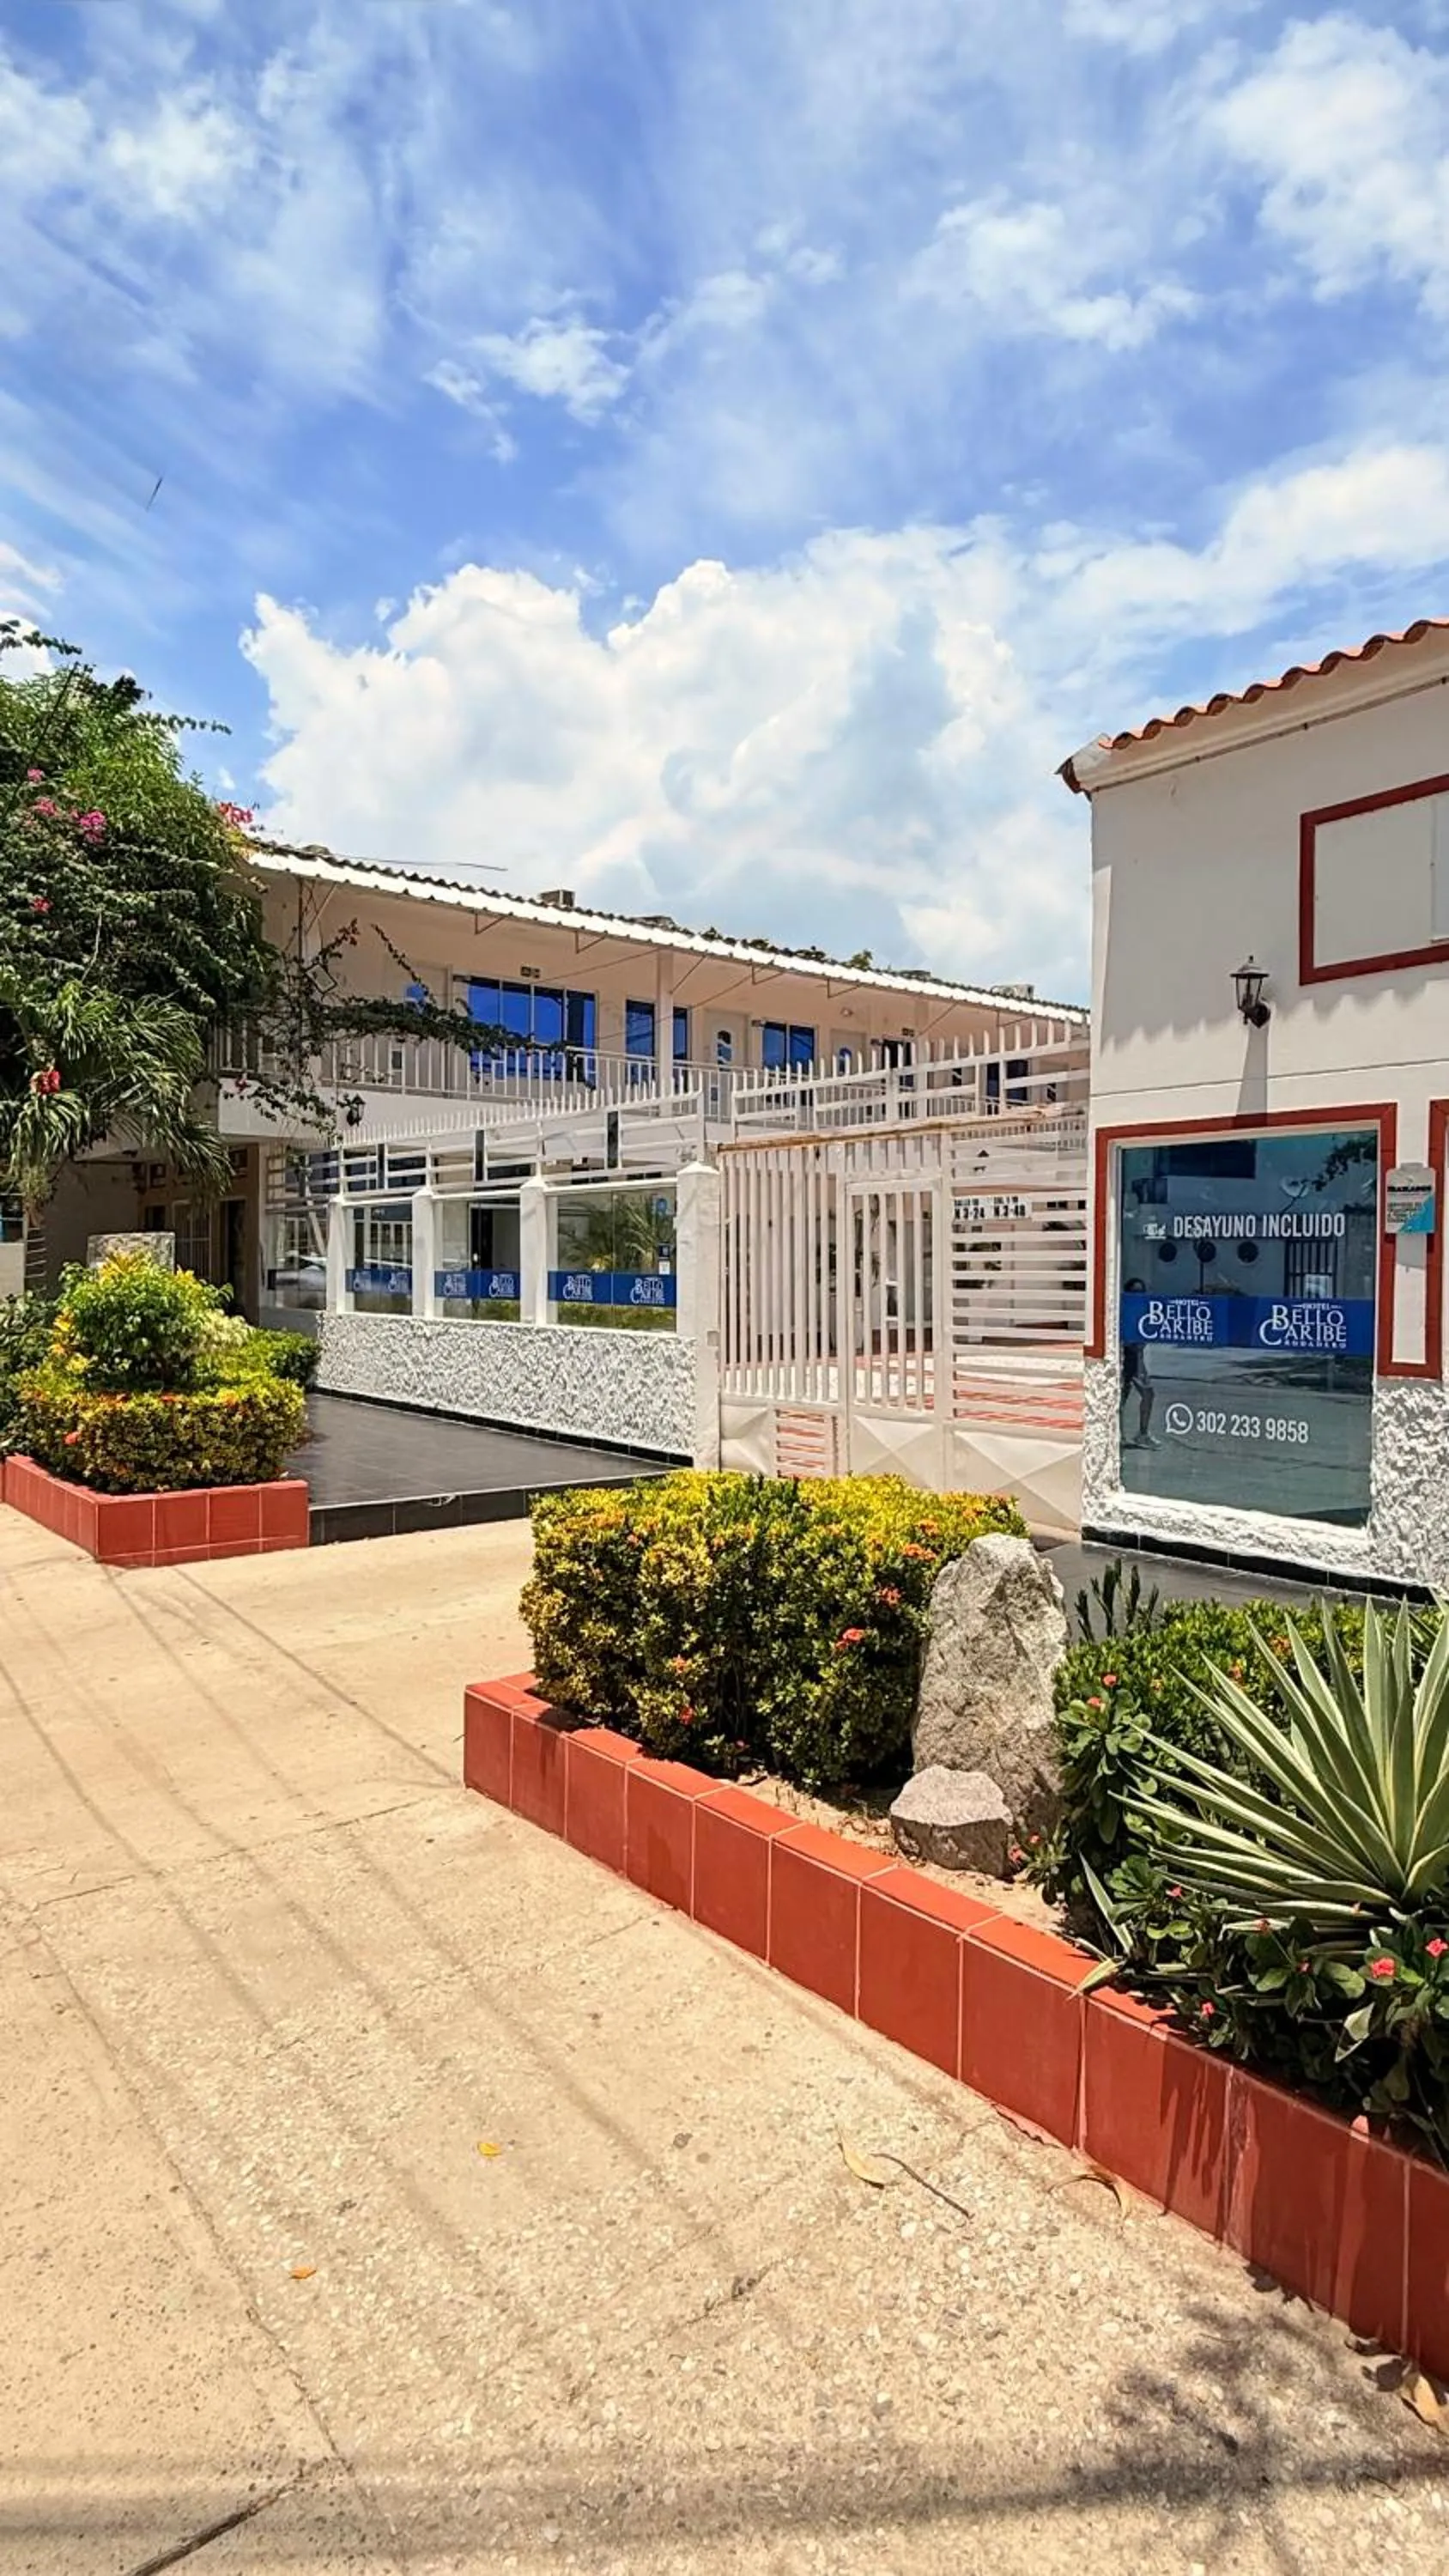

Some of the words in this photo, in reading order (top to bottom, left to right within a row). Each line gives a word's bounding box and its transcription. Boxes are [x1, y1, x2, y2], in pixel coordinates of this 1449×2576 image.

[1173, 1215, 1256, 1238] DESAYUNO
[1262, 1212, 1346, 1237] INCLUIDO
[1149, 1301, 1211, 1325] BELLO
[1271, 1304, 1344, 1330] BELLO
[1138, 1314, 1214, 1339] CARIBE
[1259, 1318, 1347, 1346] CARIBE
[1197, 1411, 1227, 1435] 302
[1230, 1414, 1261, 1438] 233
[1265, 1418, 1309, 1443] 9858
